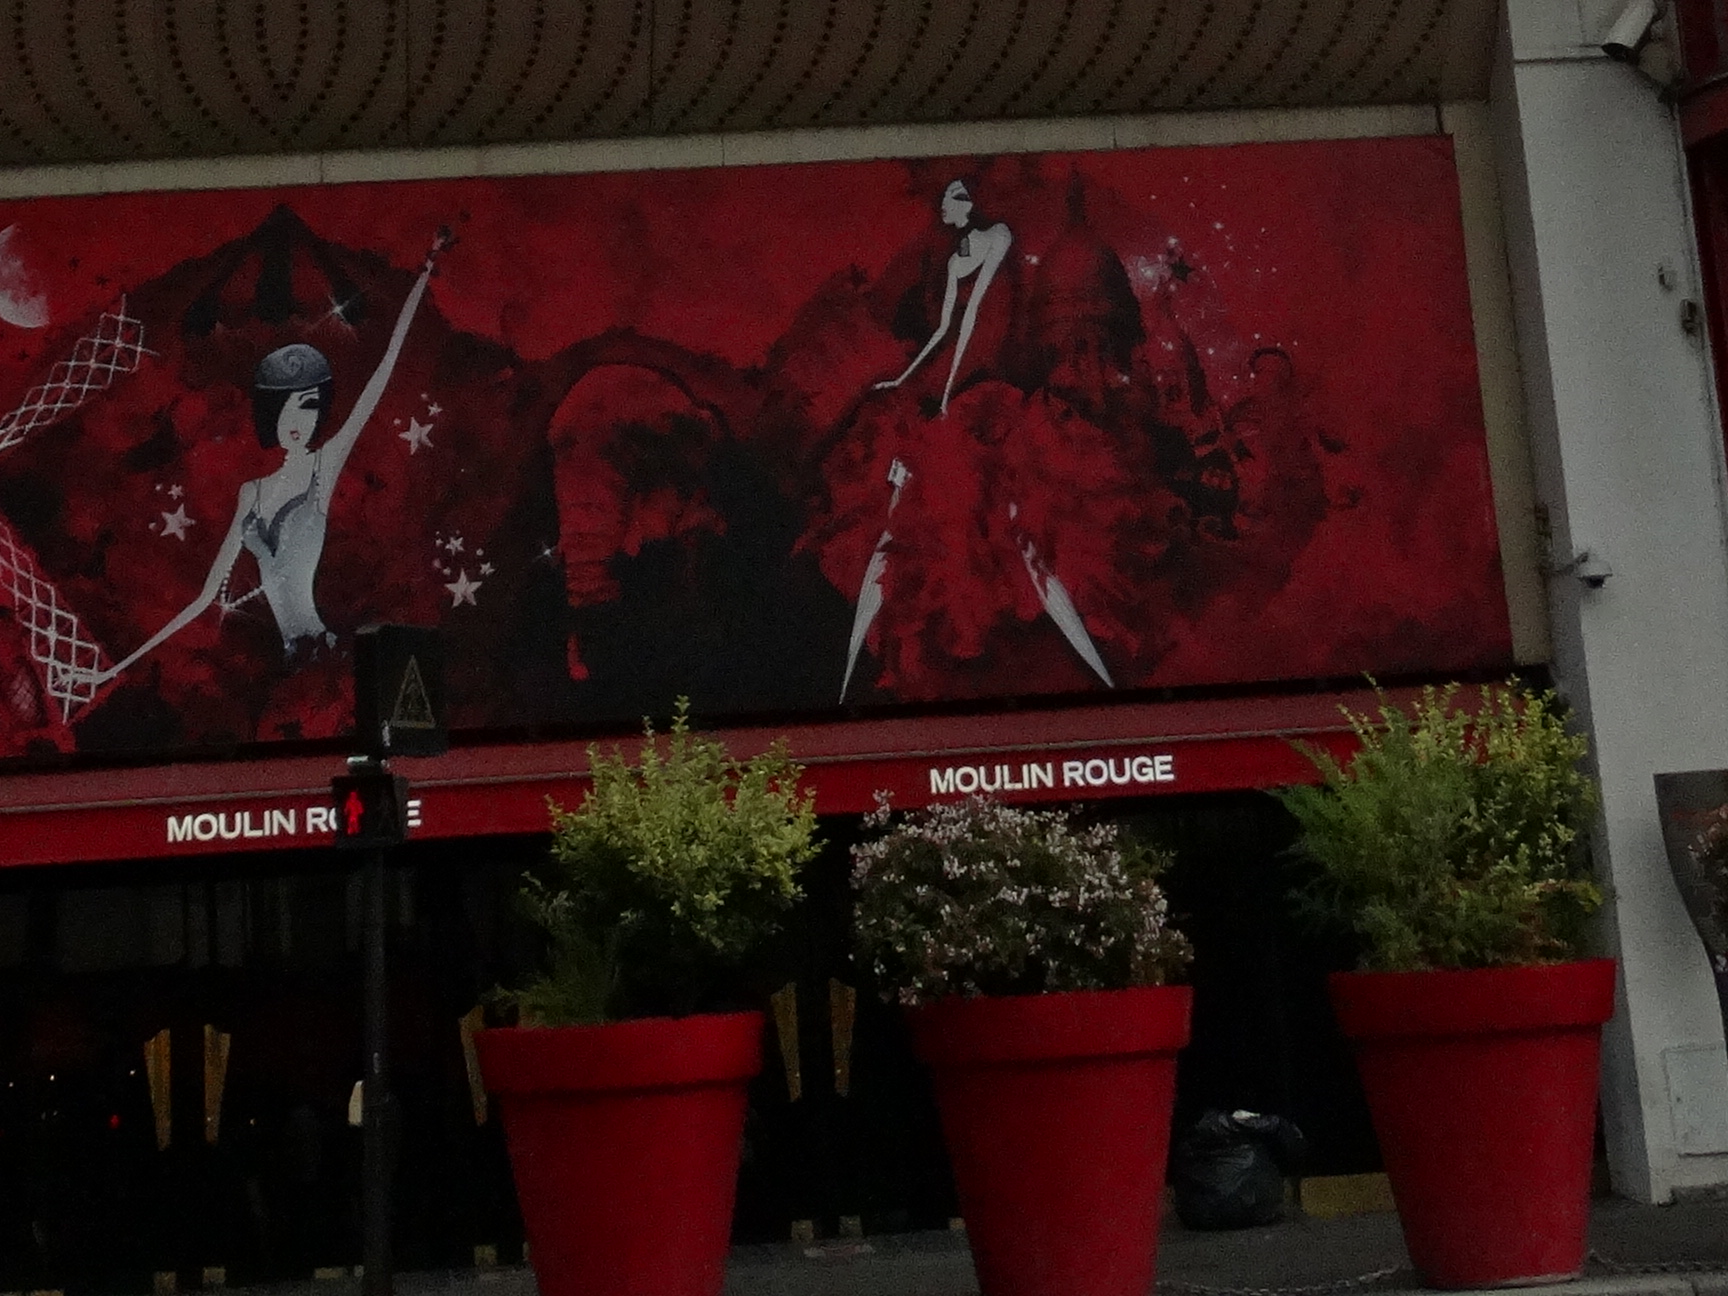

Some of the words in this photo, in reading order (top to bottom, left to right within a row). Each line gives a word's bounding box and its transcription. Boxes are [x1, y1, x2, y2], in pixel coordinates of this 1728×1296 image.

[929, 762, 1053, 794] MOULIN
[1063, 755, 1175, 787] ROUGE
[167, 807, 295, 843] MOULIN
